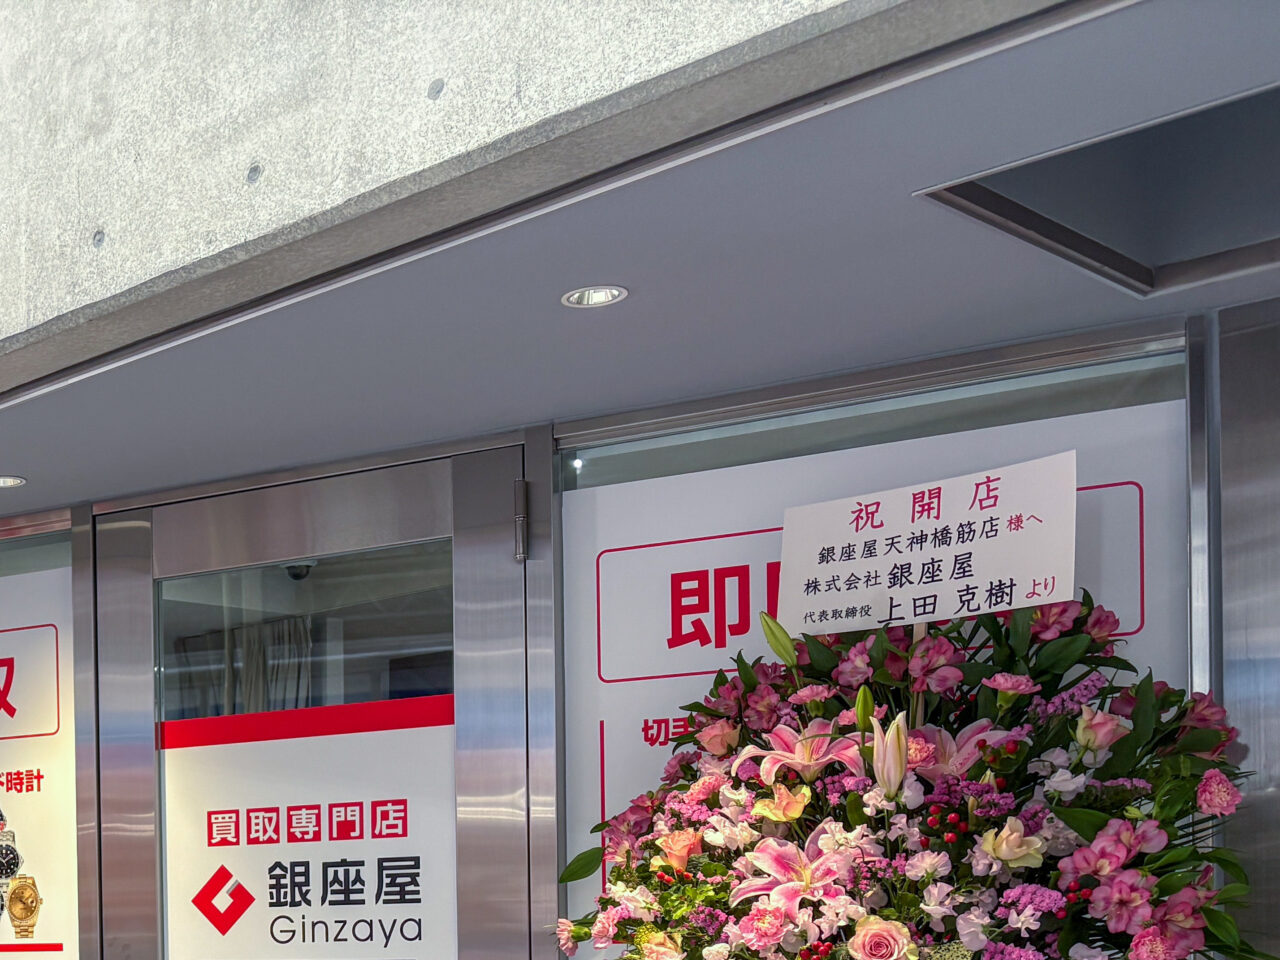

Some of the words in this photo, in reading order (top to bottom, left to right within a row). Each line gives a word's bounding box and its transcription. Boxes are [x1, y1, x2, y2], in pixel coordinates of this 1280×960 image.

[887, 552, 975, 589] 銀座屋
[210, 802, 405, 844] 買取専門店
[268, 856, 422, 907] 銀座屋
[270, 914, 422, 948] Ginzaya
